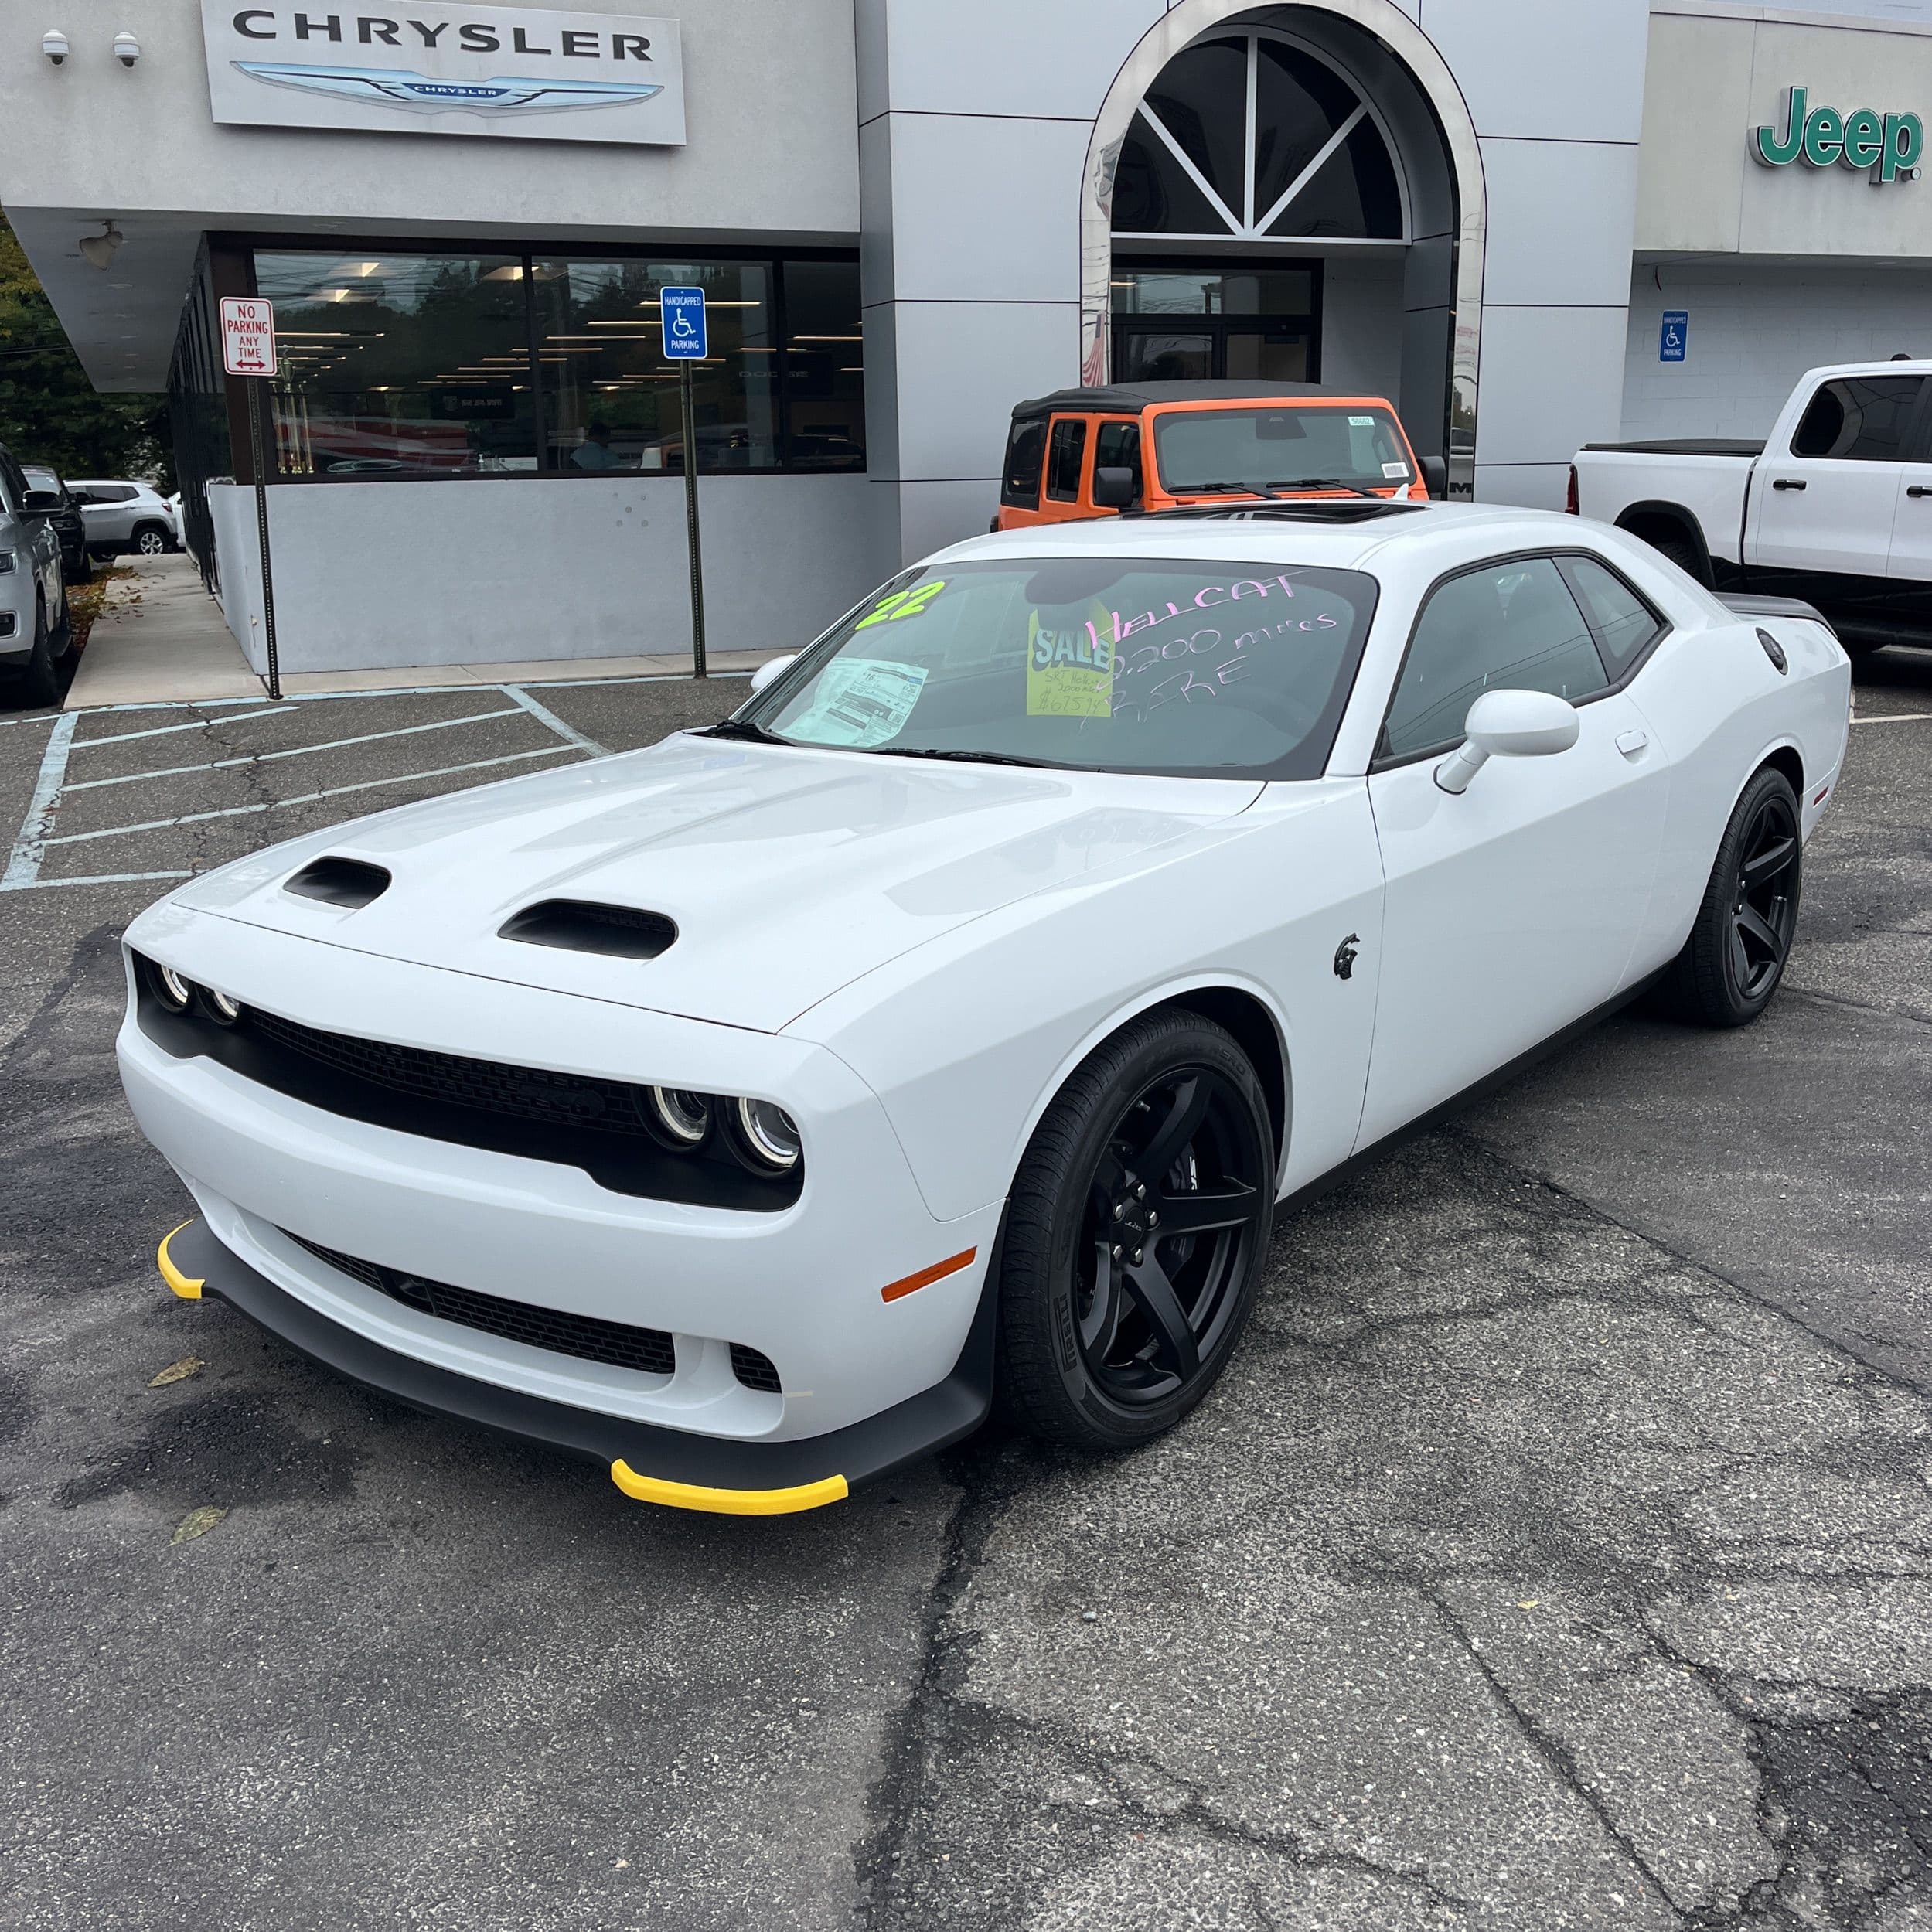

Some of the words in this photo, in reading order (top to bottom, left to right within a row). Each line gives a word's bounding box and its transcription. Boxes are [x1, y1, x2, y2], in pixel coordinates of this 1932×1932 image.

[232, 9, 653, 62] CHRYSLER
[414, 86, 496, 96] CHRYSLER
[1757, 85, 1924, 183] Jeep
[664, 296, 702, 306] HANDICAPPED
[238, 305, 255, 319] NO
[227, 319, 268, 334] PARKING
[239, 336, 259, 347] ANY
[670, 339, 700, 349] PARKING
[238, 346, 261, 359] TIME
[854, 581, 946, 630] 22
[1085, 570, 1312, 650] HELLCAT
[1034, 628, 1110, 671] SALE
